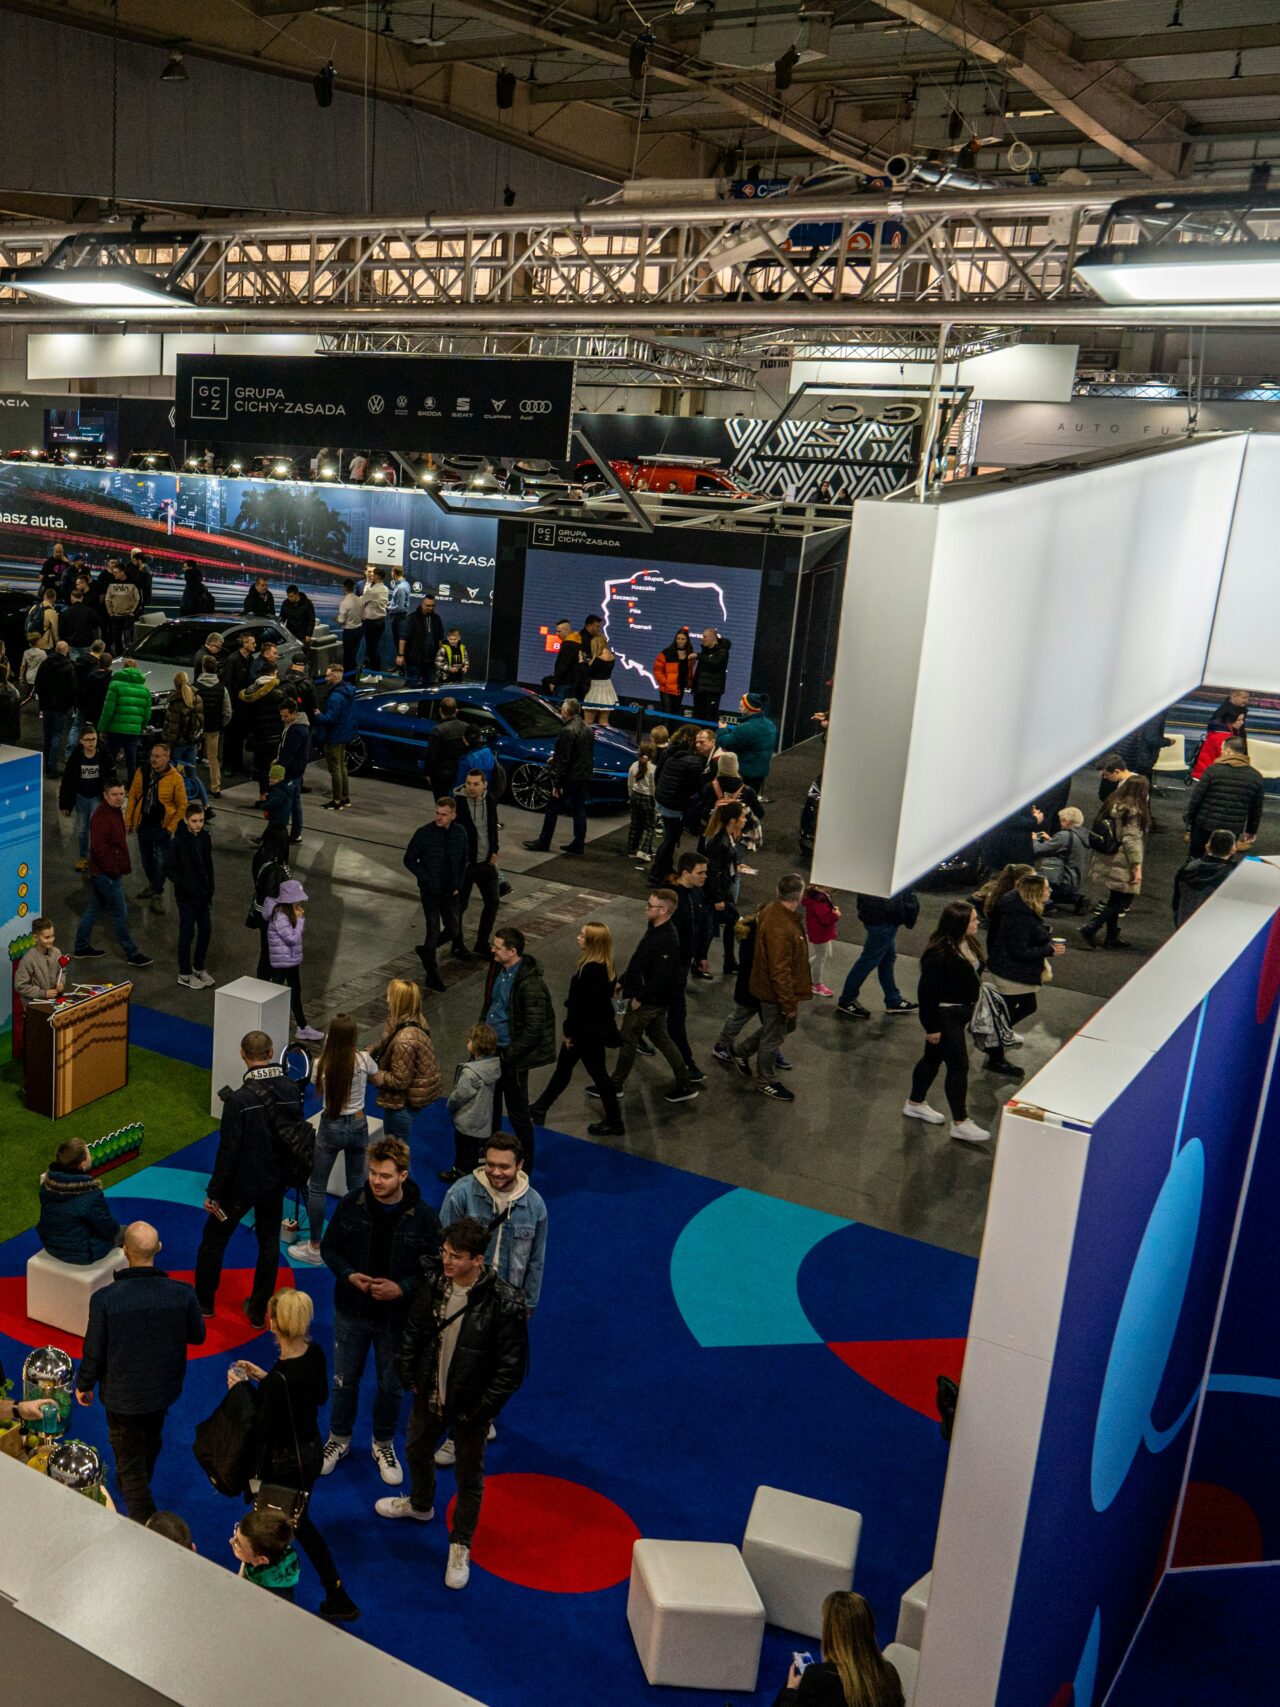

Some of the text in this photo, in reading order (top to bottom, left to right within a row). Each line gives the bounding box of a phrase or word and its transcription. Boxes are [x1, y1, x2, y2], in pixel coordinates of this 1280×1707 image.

[234, 387, 286, 400] GRUPA
[234, 400, 347, 416] CICHY-ZASADA
[1057, 422, 1120, 434] AUTO
[30, 516, 68, 530] auta.
[558, 529, 587, 538] GRUPA
[410, 538, 460, 552] GRUPA
[557, 536, 621, 548] CICHY-ZASADA
[631, 584, 656, 592] Koszalin
[629, 623, 652, 631] Poznań
